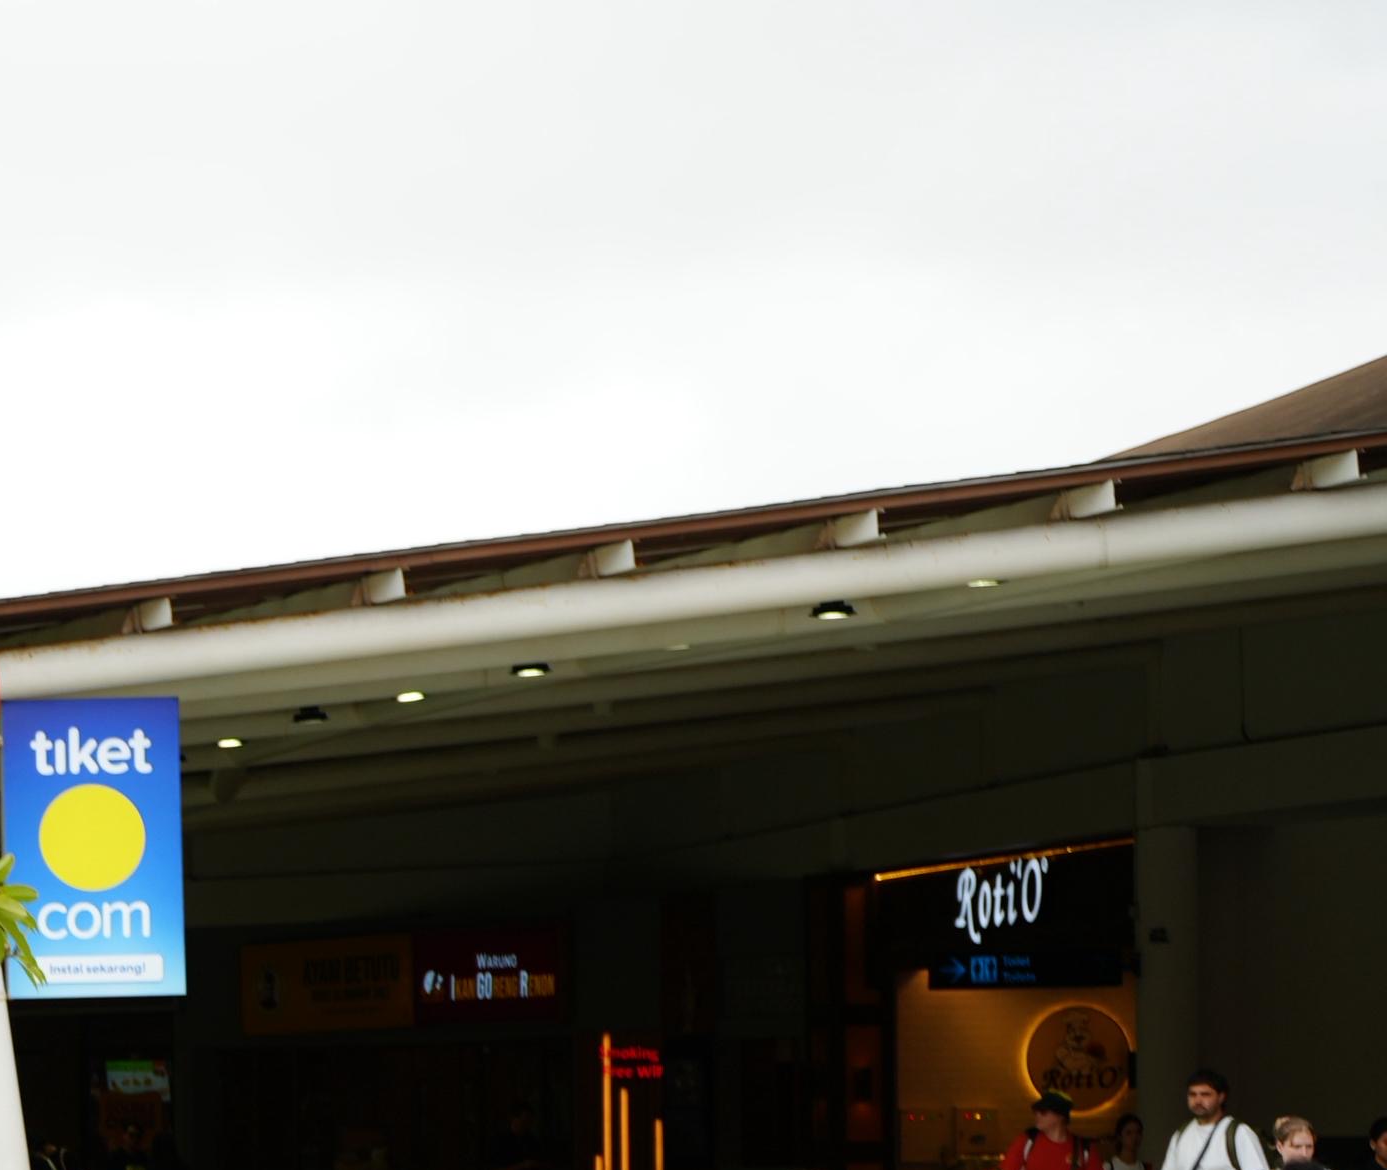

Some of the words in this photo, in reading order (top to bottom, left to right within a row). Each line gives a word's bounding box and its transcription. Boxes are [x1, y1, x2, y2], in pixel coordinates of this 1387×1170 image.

[30, 727, 153, 776] tiket
[38, 900, 151, 940] com
[86, 961, 147, 977] sekarang!
